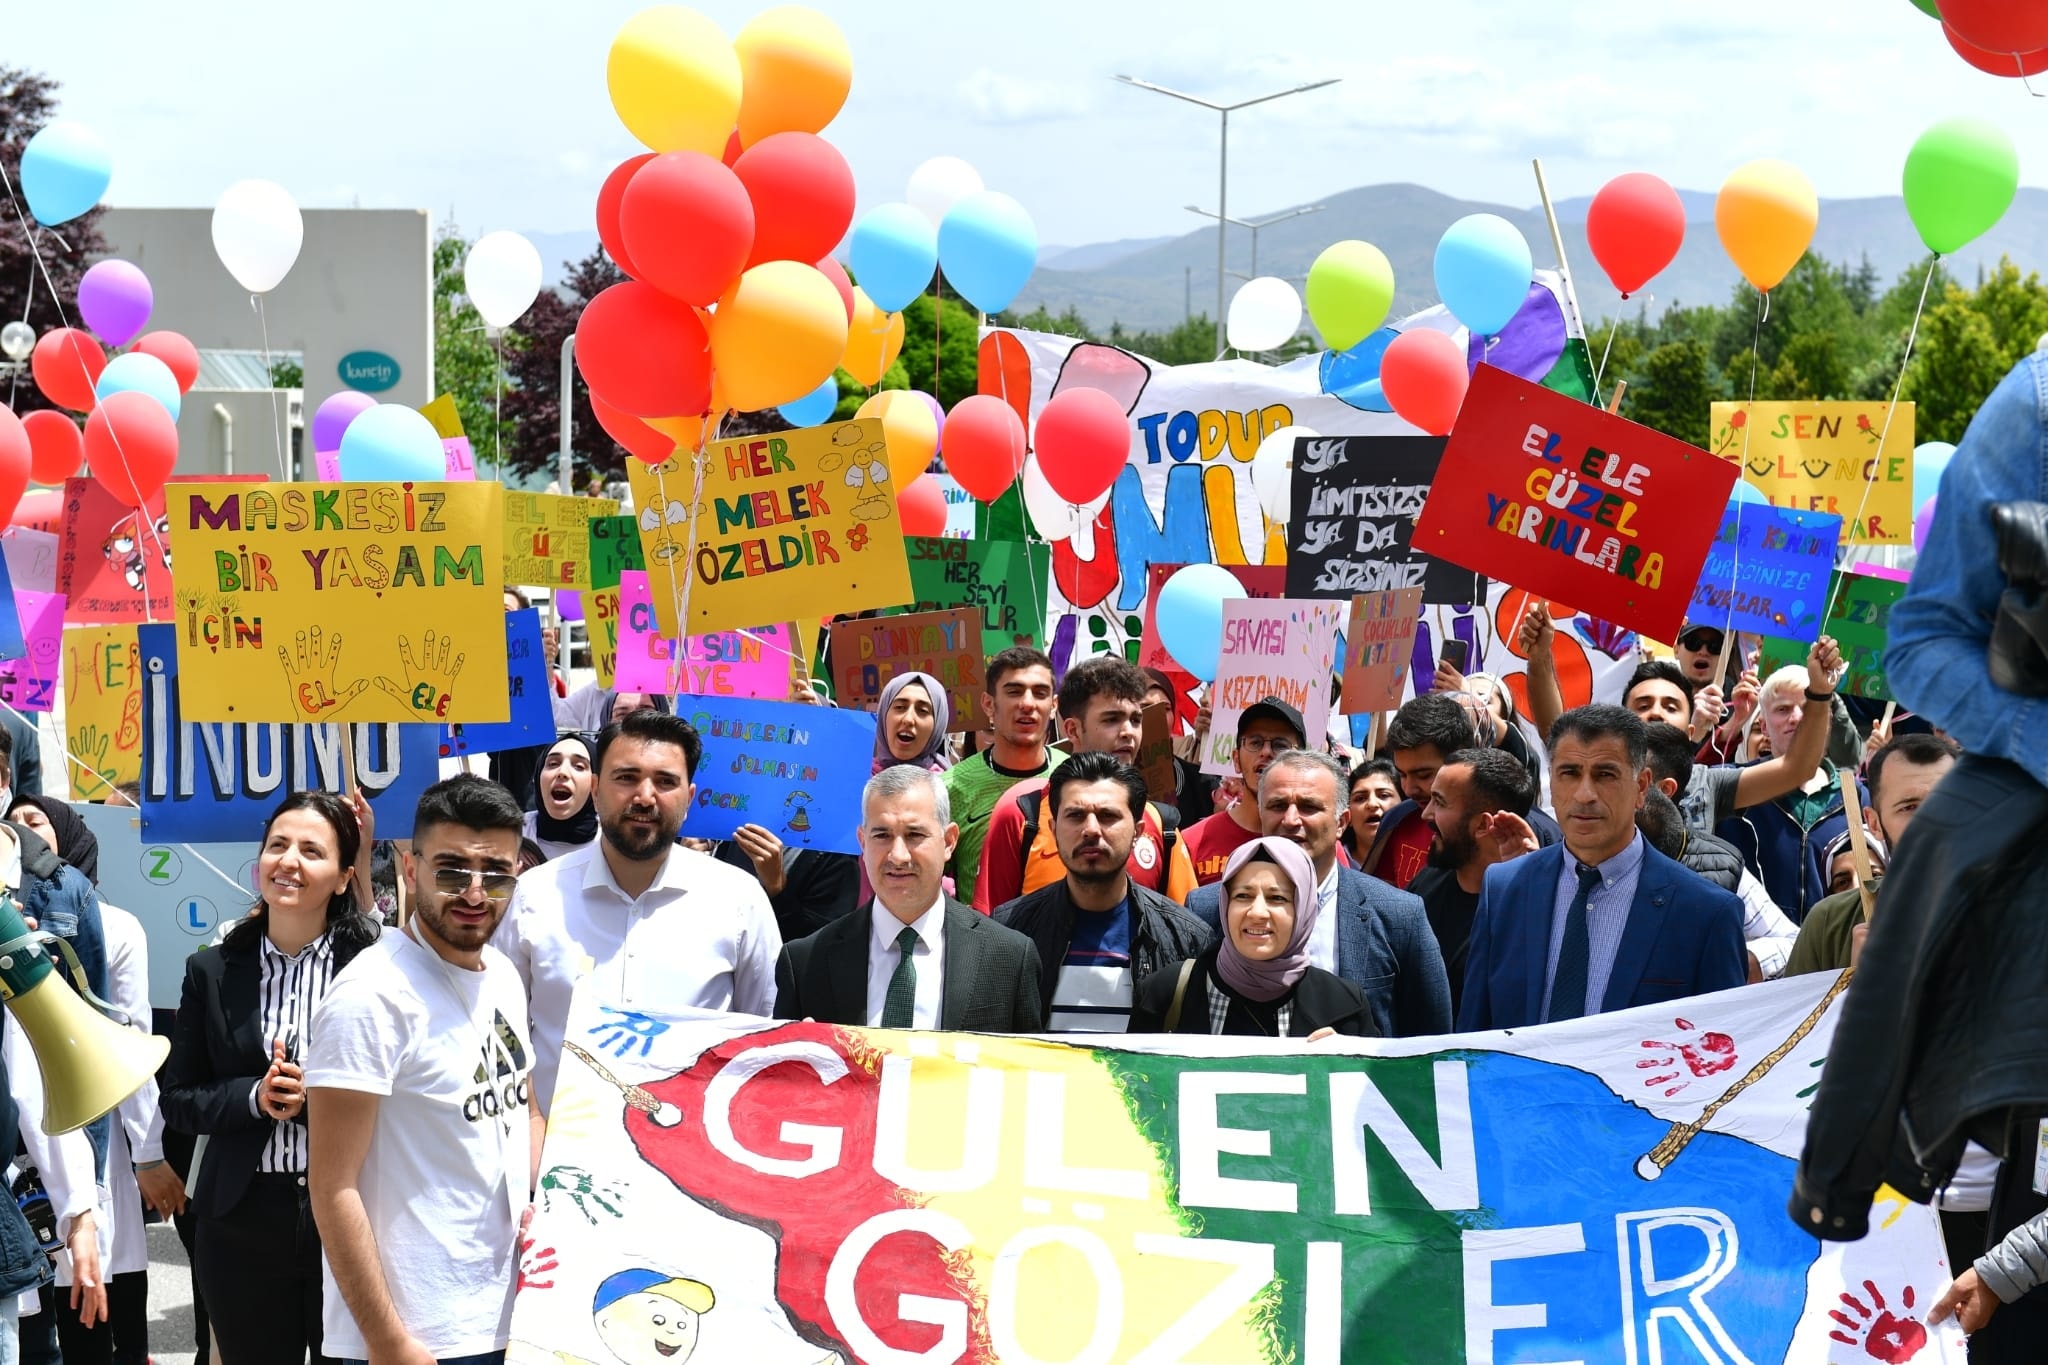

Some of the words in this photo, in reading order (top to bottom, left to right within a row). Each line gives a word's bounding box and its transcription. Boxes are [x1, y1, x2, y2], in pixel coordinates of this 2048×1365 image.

[1771, 414, 1842, 439] SEN
[724, 438, 795, 481] HER
[1300, 438, 1349, 473] YA
[1522, 423, 1562, 464] EL
[1580, 446, 1651, 496] ELE
[189, 482, 446, 534] MASKESİZ
[714, 481, 830, 535] MELEK
[1526, 467, 1638, 538] GÜZEL
[513, 527, 589, 560] GÜZE
[697, 524, 840, 585] ÖZELDİR
[1296, 519, 1344, 554] YA
[1355, 521, 1398, 552] DA
[1487, 493, 1664, 590] YARINLARA
[214, 545, 278, 592] BİR
[302, 544, 484, 598] YAŞAM
[943, 562, 980, 583] HER
[189, 600, 262, 653] İÇİN
[858, 619, 967, 660] DÜNYAYI
[1223, 618, 1287, 656] SAVAŞI
[299, 680, 336, 713] EL
[412, 682, 450, 717] ELE
[703, 1038, 1480, 1216] GÜLEN
